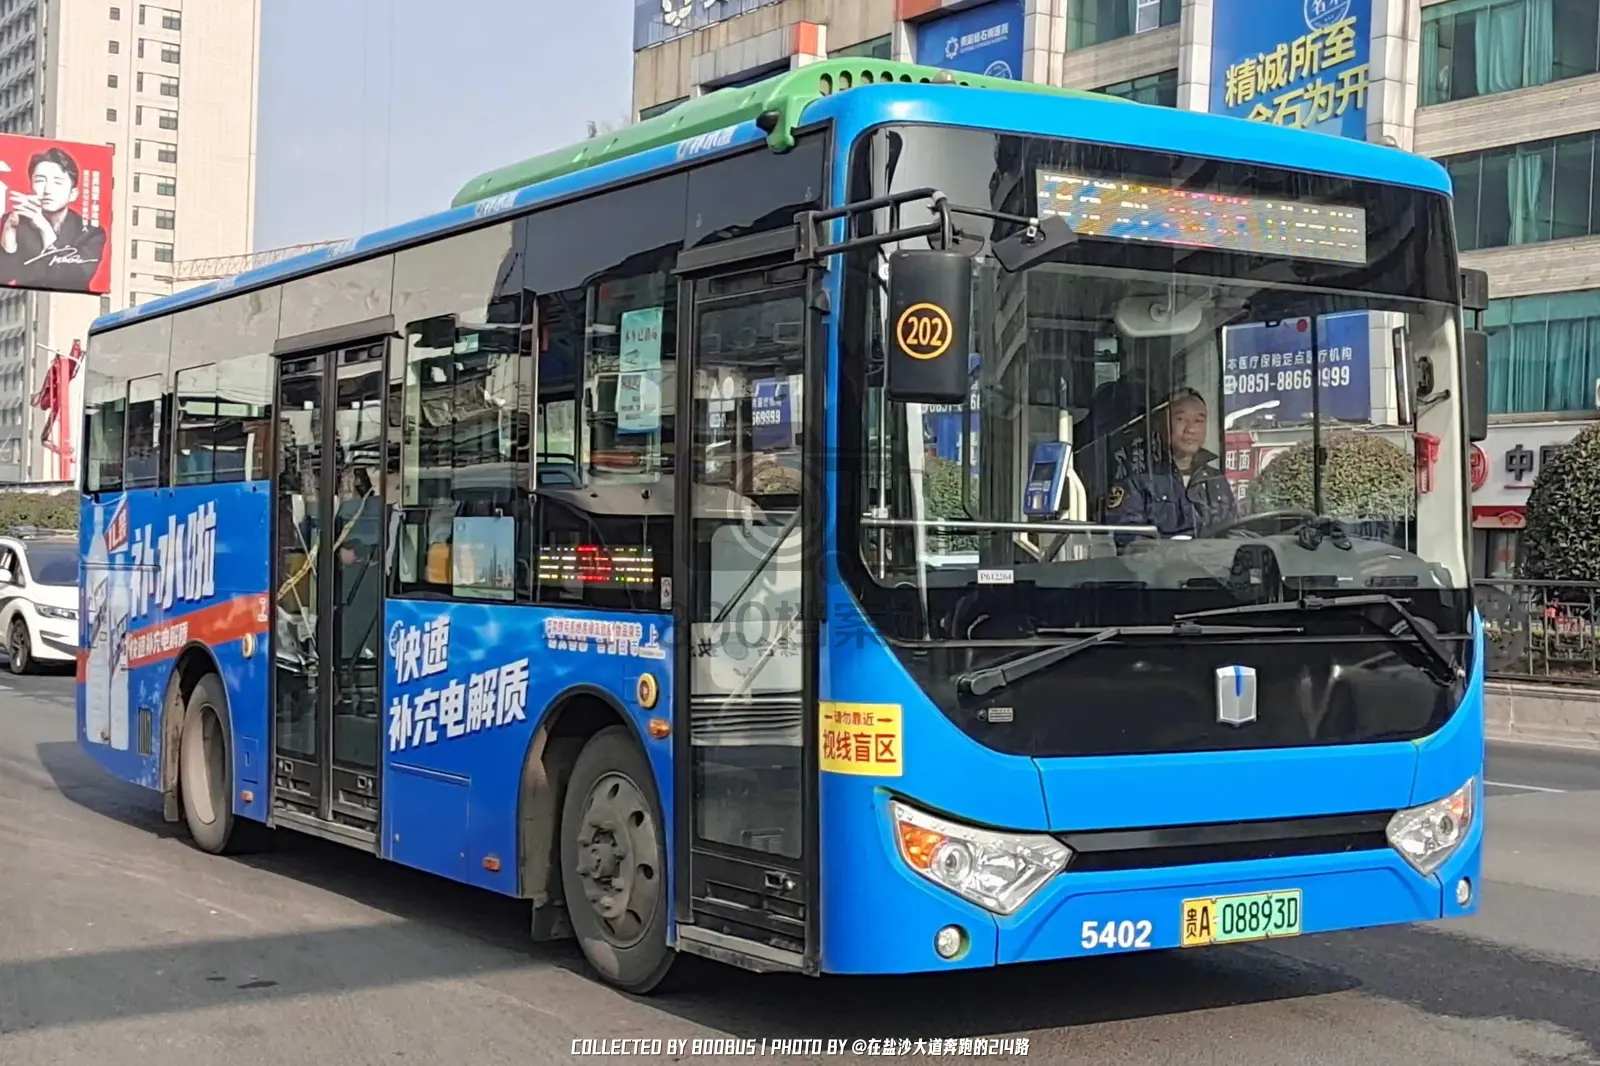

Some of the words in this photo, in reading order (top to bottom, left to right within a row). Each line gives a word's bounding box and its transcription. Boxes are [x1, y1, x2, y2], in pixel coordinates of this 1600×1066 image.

[1225, 16, 1356, 108] 精诚所至
[906, 316, 943, 347] 202
[1238, 366, 1350, 394] 0851-8866999
[395, 615, 451, 685] 快速
[389, 657, 530, 752] 补充电解质
[823, 729, 897, 763] 视线盲区
[1081, 920, 1152, 949] 5402
